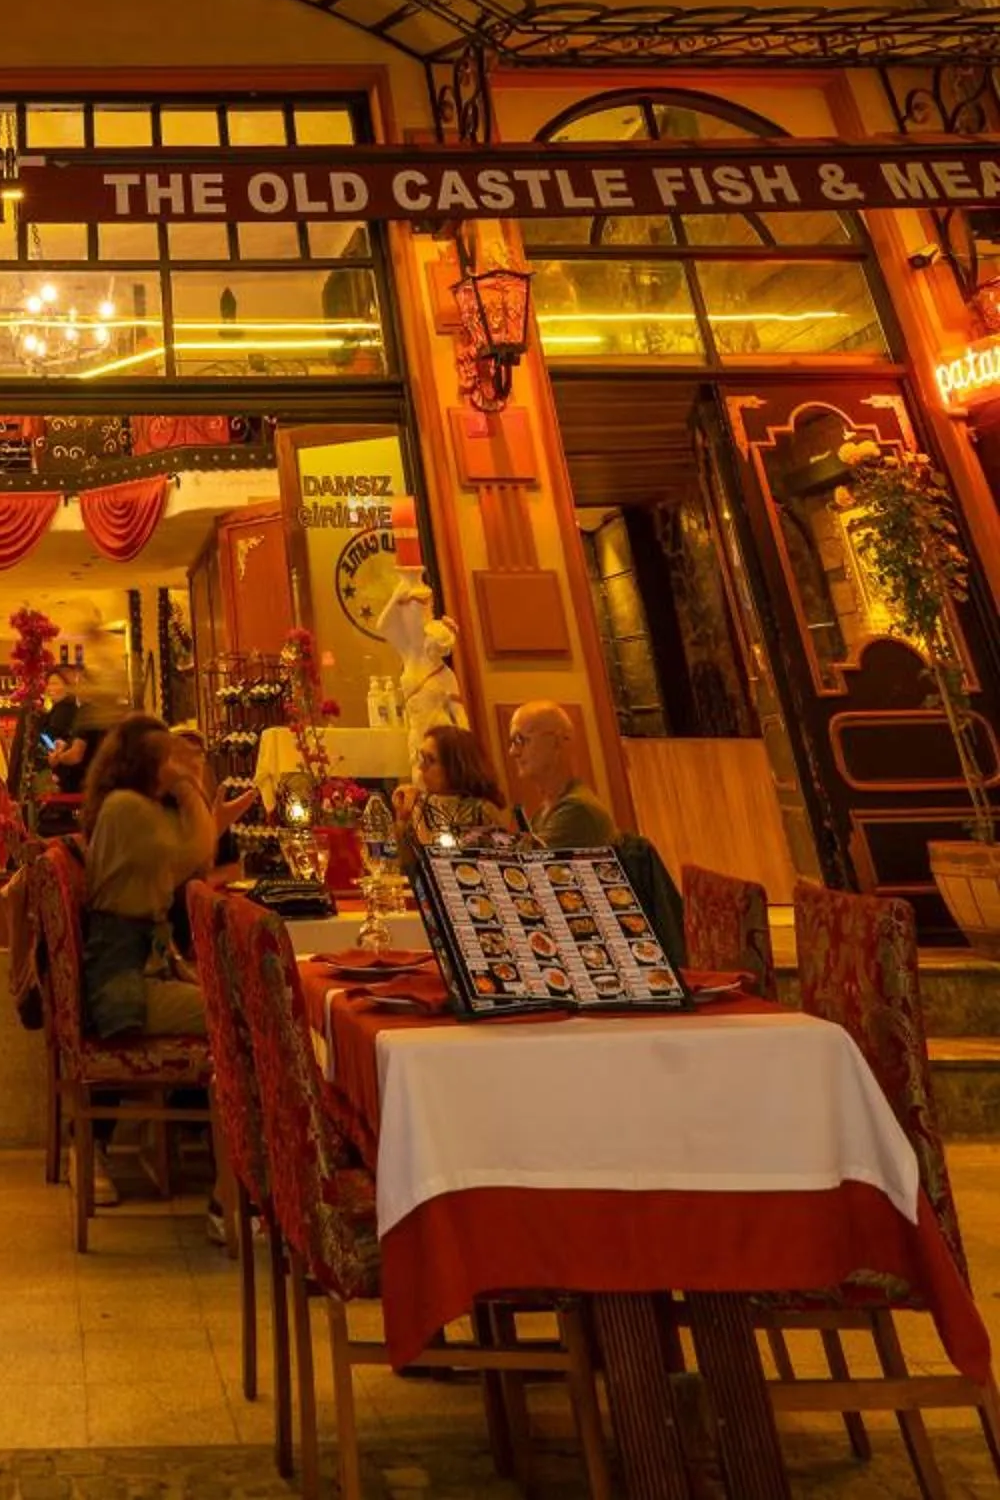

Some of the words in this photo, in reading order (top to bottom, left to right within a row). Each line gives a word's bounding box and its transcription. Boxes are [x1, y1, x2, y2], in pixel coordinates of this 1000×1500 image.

[102, 173, 226, 215] THE
[246, 172, 370, 214] OLD
[392, 169, 635, 211] CASTLE
[653, 164, 800, 207] FISH
[817, 162, 866, 202] &
[935, 345, 1000, 406] pata
[298, 501, 393, 528] GİRİLME
